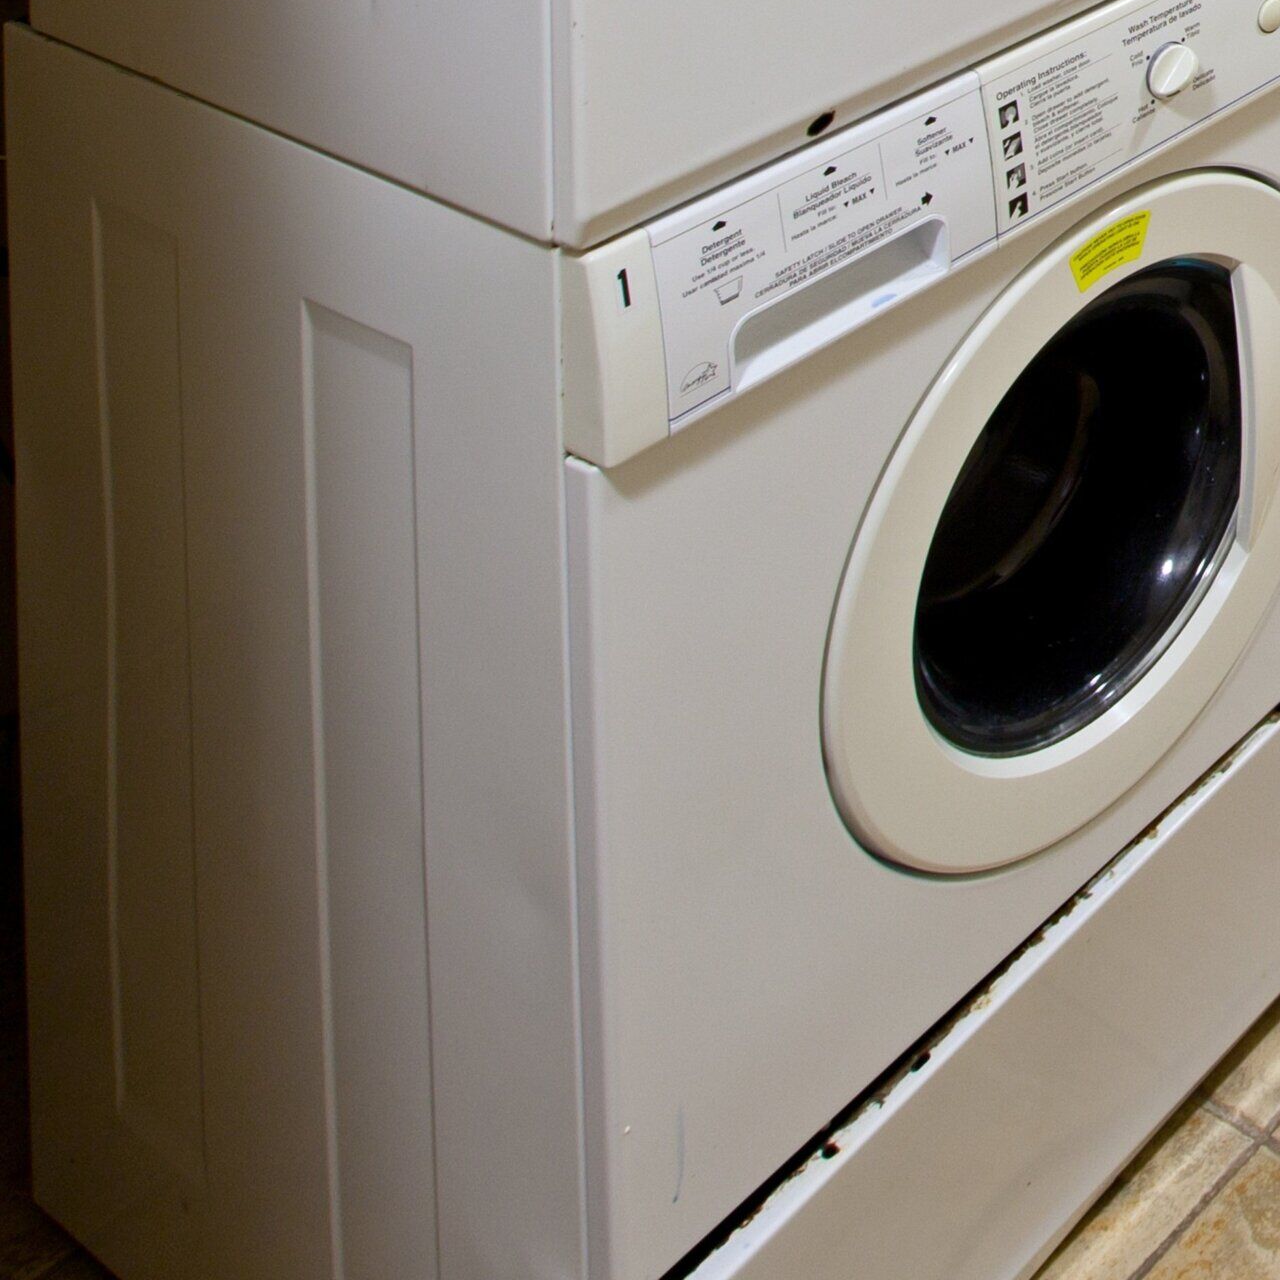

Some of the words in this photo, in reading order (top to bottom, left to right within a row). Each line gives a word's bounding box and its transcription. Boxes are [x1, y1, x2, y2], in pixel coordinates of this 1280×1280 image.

[1122, 20, 1167, 47] Temperatura
[1169, 15, 1177, 24] de
[1179, 3, 1201, 18] lavado
[1128, 21, 1149, 34] Wash
[996, 76, 1037, 101] Operating
[915, 135, 953, 157] Suavizante
[917, 127, 946, 145] Softener
[953, 142, 966, 153] MAX
[805, 185, 829, 202] Liquid
[831, 172, 857, 189] Bleach
[852, 192, 867, 205] MAX
[793, 191, 842, 219] Blanqueador
[700, 239, 745, 266] Detergente
[701, 229, 742, 254] Detergent
[775, 261, 800, 278] SAFETY
[802, 249, 824, 264] LATCH
[828, 239, 846, 250] SLIDE
[848, 232, 857, 240] TO
[857, 221, 876, 235] OPEN
[876, 207, 902, 224] DRAWER
[755, 273, 797, 299] CERRADURA
[799, 266, 807, 275] DE
[810, 246, 847, 268] SEGURIDAD
[789, 276, 807, 287] PARA
[809, 264, 830, 276] ABRIR
[617, 268, 631, 308] 1
